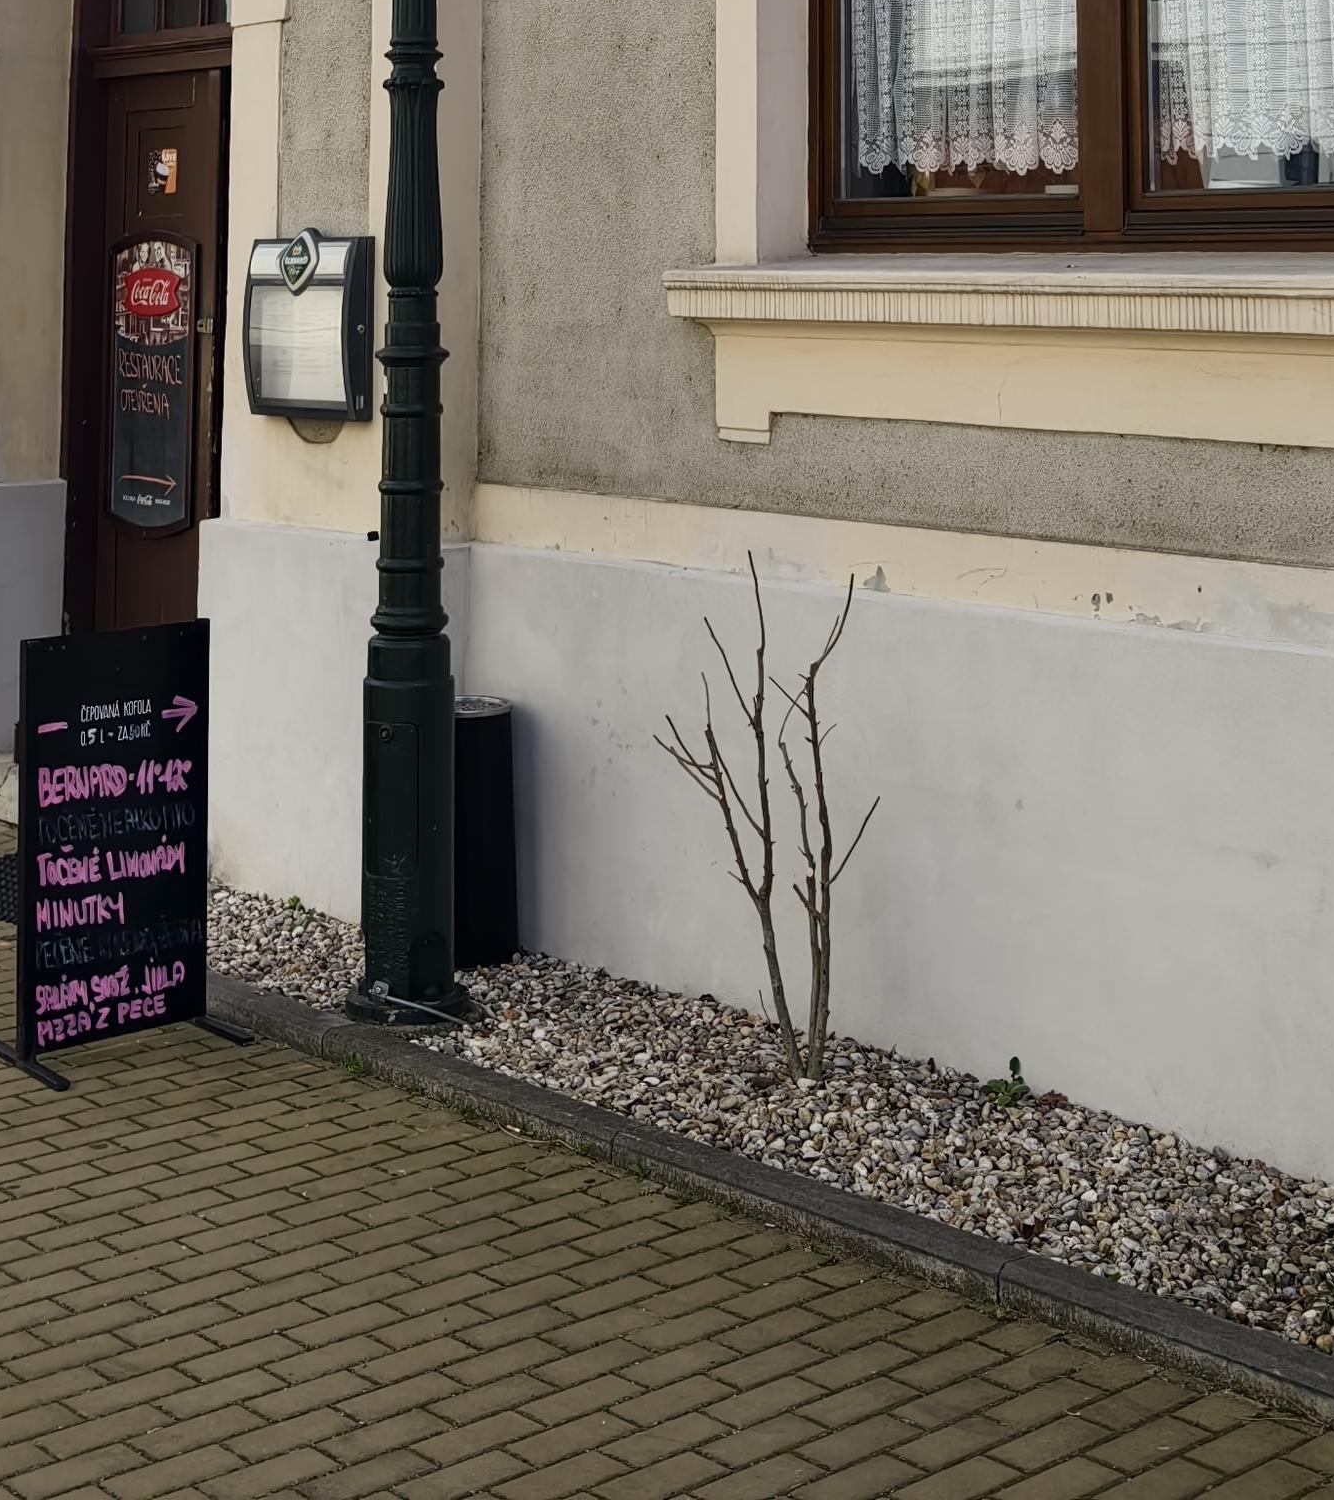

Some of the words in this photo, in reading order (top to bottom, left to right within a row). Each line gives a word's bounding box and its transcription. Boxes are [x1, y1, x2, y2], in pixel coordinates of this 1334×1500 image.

[118, 347, 183, 385] RESTAURACE
[80, 700, 120, 723] ČEPOVANÁ
[123, 699, 152, 716] KOFOLA
[36, 891, 125, 932] MINUTKY
